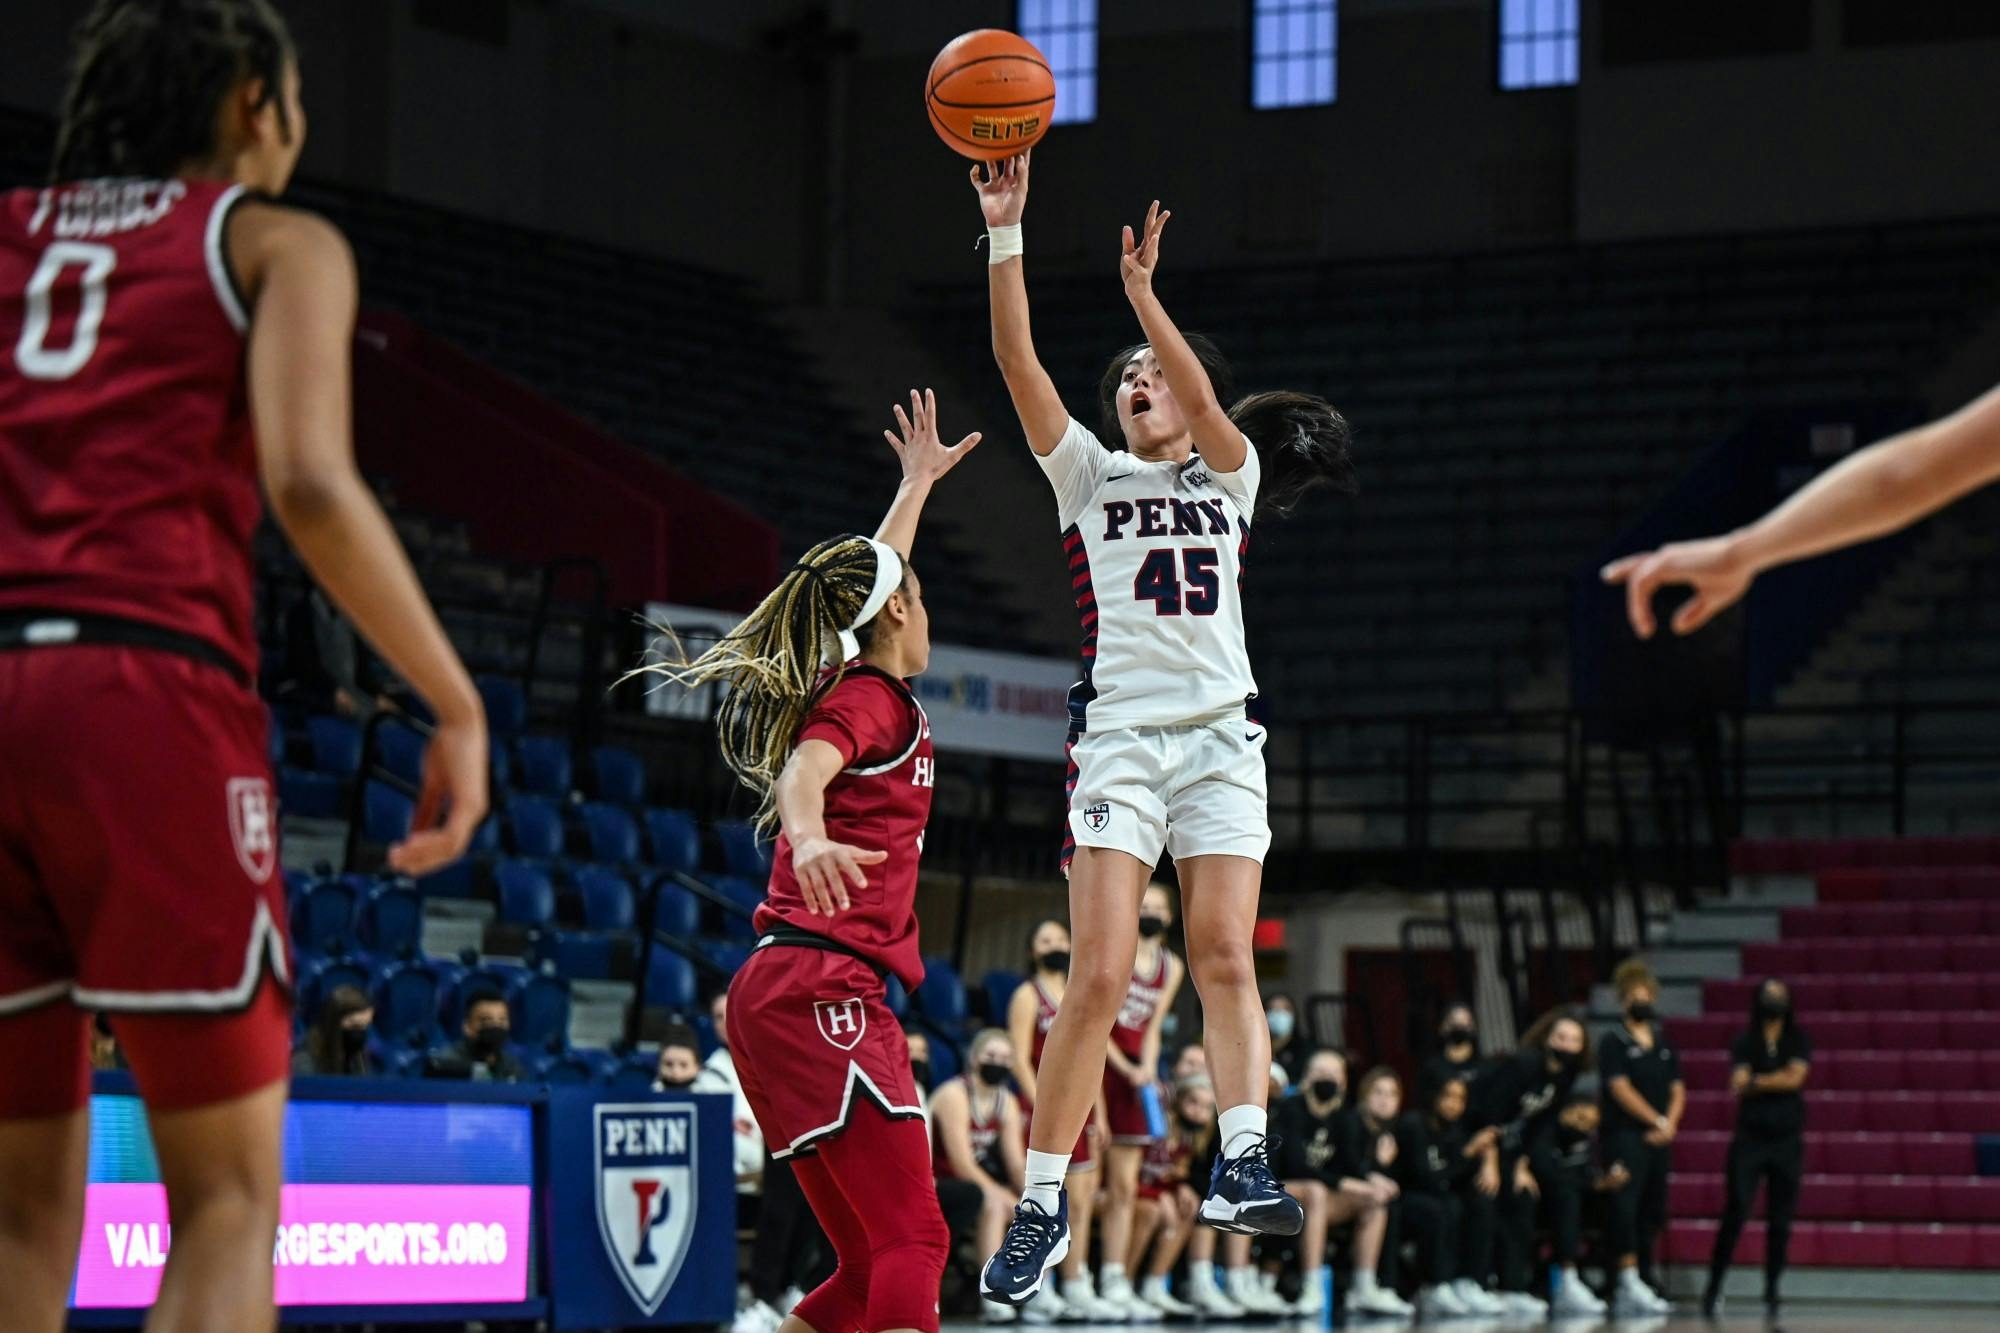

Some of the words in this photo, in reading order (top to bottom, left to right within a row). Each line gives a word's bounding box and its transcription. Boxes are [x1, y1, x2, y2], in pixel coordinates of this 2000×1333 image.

[972, 116, 1040, 139] ELITE
[15, 240, 116, 380] 0
[1103, 497, 1230, 541] PENN
[1134, 548, 1219, 616] 45
[827, 1002, 857, 1035] H
[605, 1118, 688, 1156] PENN
[632, 1178, 671, 1266] P
